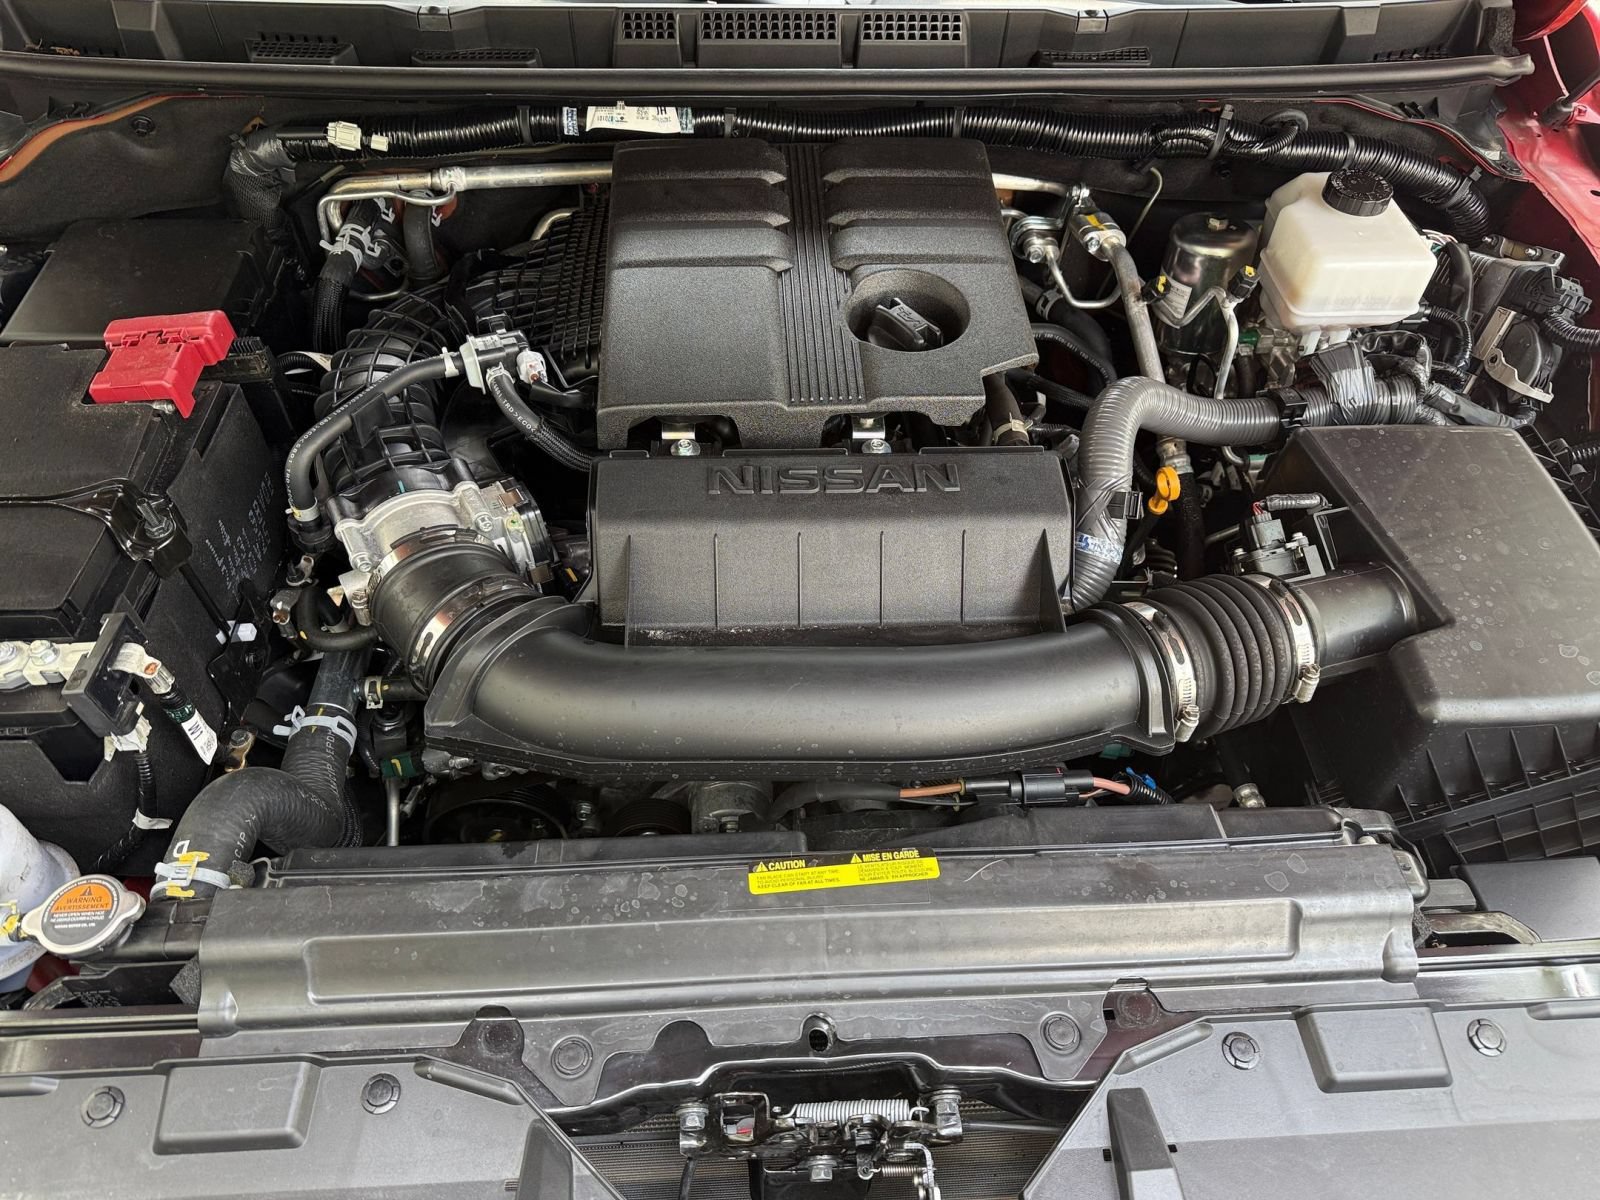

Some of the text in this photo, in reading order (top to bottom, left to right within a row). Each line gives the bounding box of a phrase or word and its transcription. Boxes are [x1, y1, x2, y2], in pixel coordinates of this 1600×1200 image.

[708, 464, 960, 494] NISSAN
[862, 850, 920, 862] MISE EN GARDE
[768, 860, 806, 871] CAUTION
[66, 896, 102, 904] WARNING
